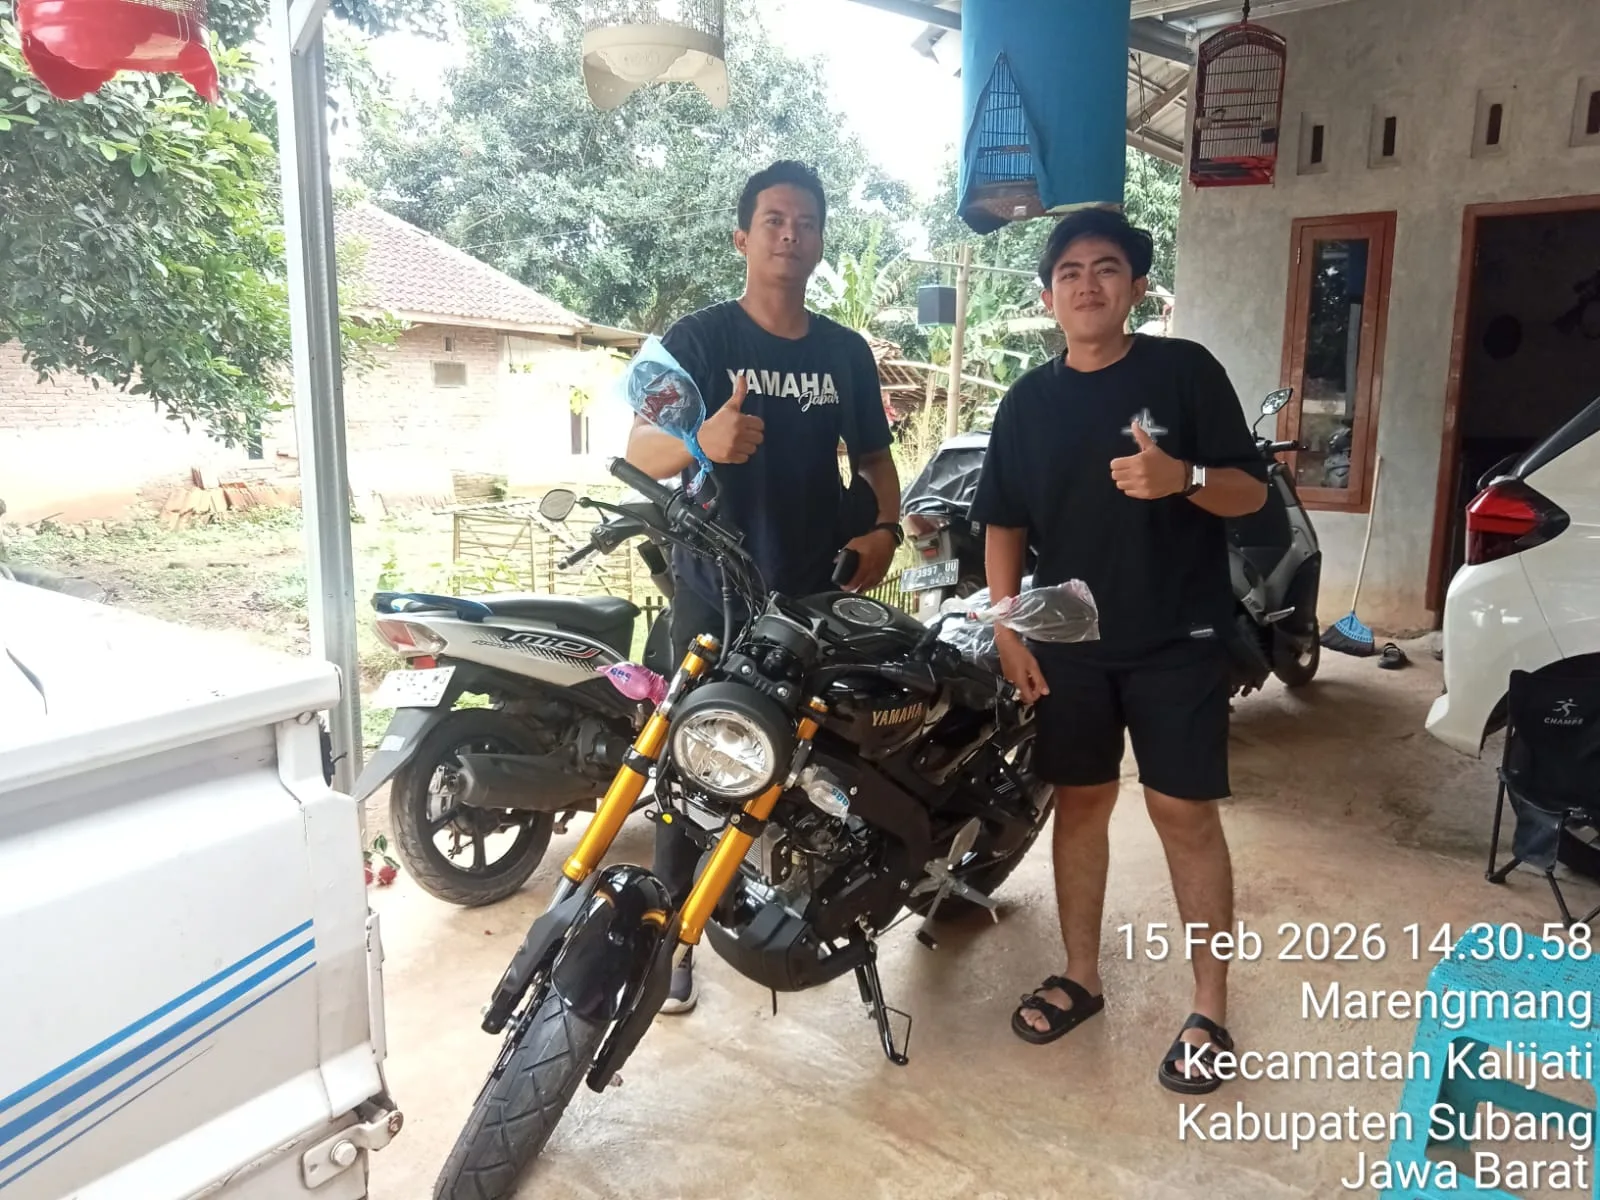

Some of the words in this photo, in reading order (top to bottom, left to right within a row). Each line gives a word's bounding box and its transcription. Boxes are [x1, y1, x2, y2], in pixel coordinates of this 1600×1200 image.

[726, 368, 835, 398] YAMAHA
[798, 389, 840, 412] Jabar
[872, 702, 923, 727] YAMAHA
